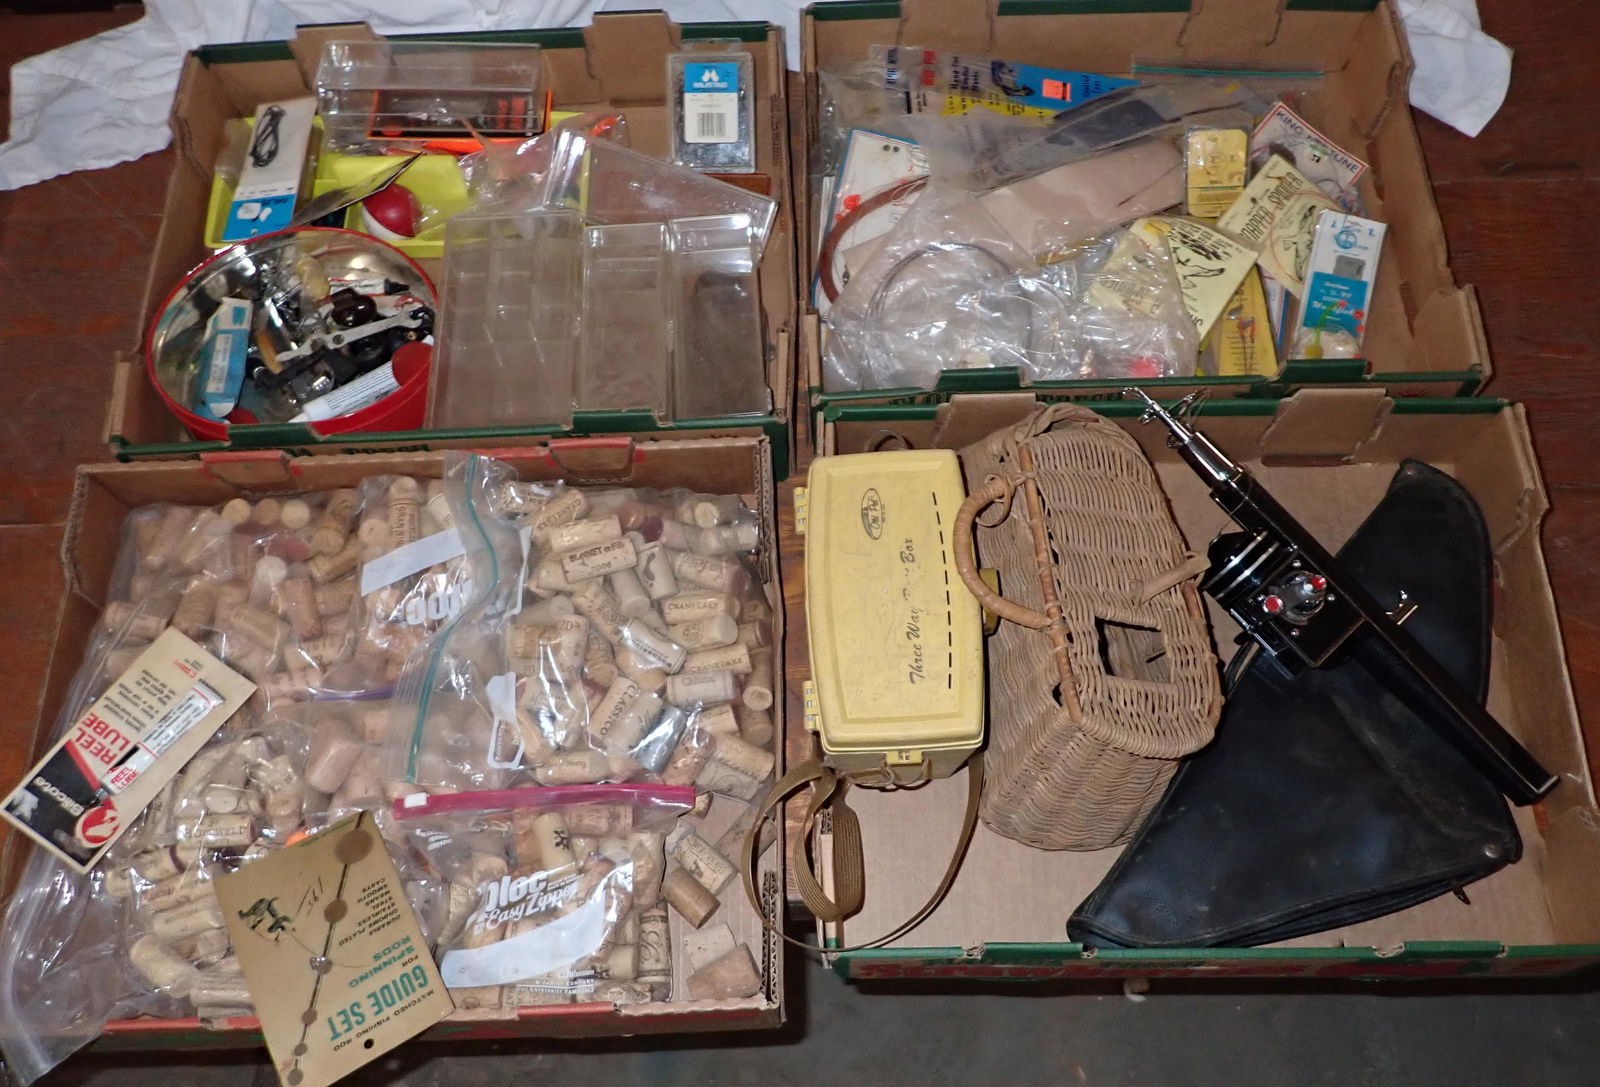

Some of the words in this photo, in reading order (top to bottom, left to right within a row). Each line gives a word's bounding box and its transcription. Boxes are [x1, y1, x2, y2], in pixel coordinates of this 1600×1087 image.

[1277, 110, 1304, 138] KING
[1239, 205, 1273, 241] NAPPER
[900, 538, 916, 565] Box
[906, 607, 924, 641] Way
[909, 643, 925, 685] Three
[600, 683, 640, 737] CLASSICO
[82, 712, 131, 751] LUBE
[73, 727, 118, 766] REEL
[110, 766, 134, 785] REEL
[357, 883, 388, 904] SMOOTH
[361, 877, 386, 893] CASTS
[365, 889, 391, 907] MEANS
[357, 902, 396, 926] STAINLESS
[372, 896, 393, 910] STEEL
[486, 905, 524, 931] Easy
[525, 881, 579, 916] Zipper
[368, 908, 399, 929] CHROME
[368, 915, 400, 936] DURABLE
[338, 927, 367, 947] PLATED
[372, 935, 411, 961] RODS
[349, 945, 415, 988] SPINNING
[401, 954, 419, 968] FOR
[367, 965, 429, 1015] GUIDE
[393, 989, 434, 1016] MATCHED
[326, 999, 366, 1040] SET
[355, 1015, 390, 1039] FISHING
[333, 1037, 352, 1051] ROD
